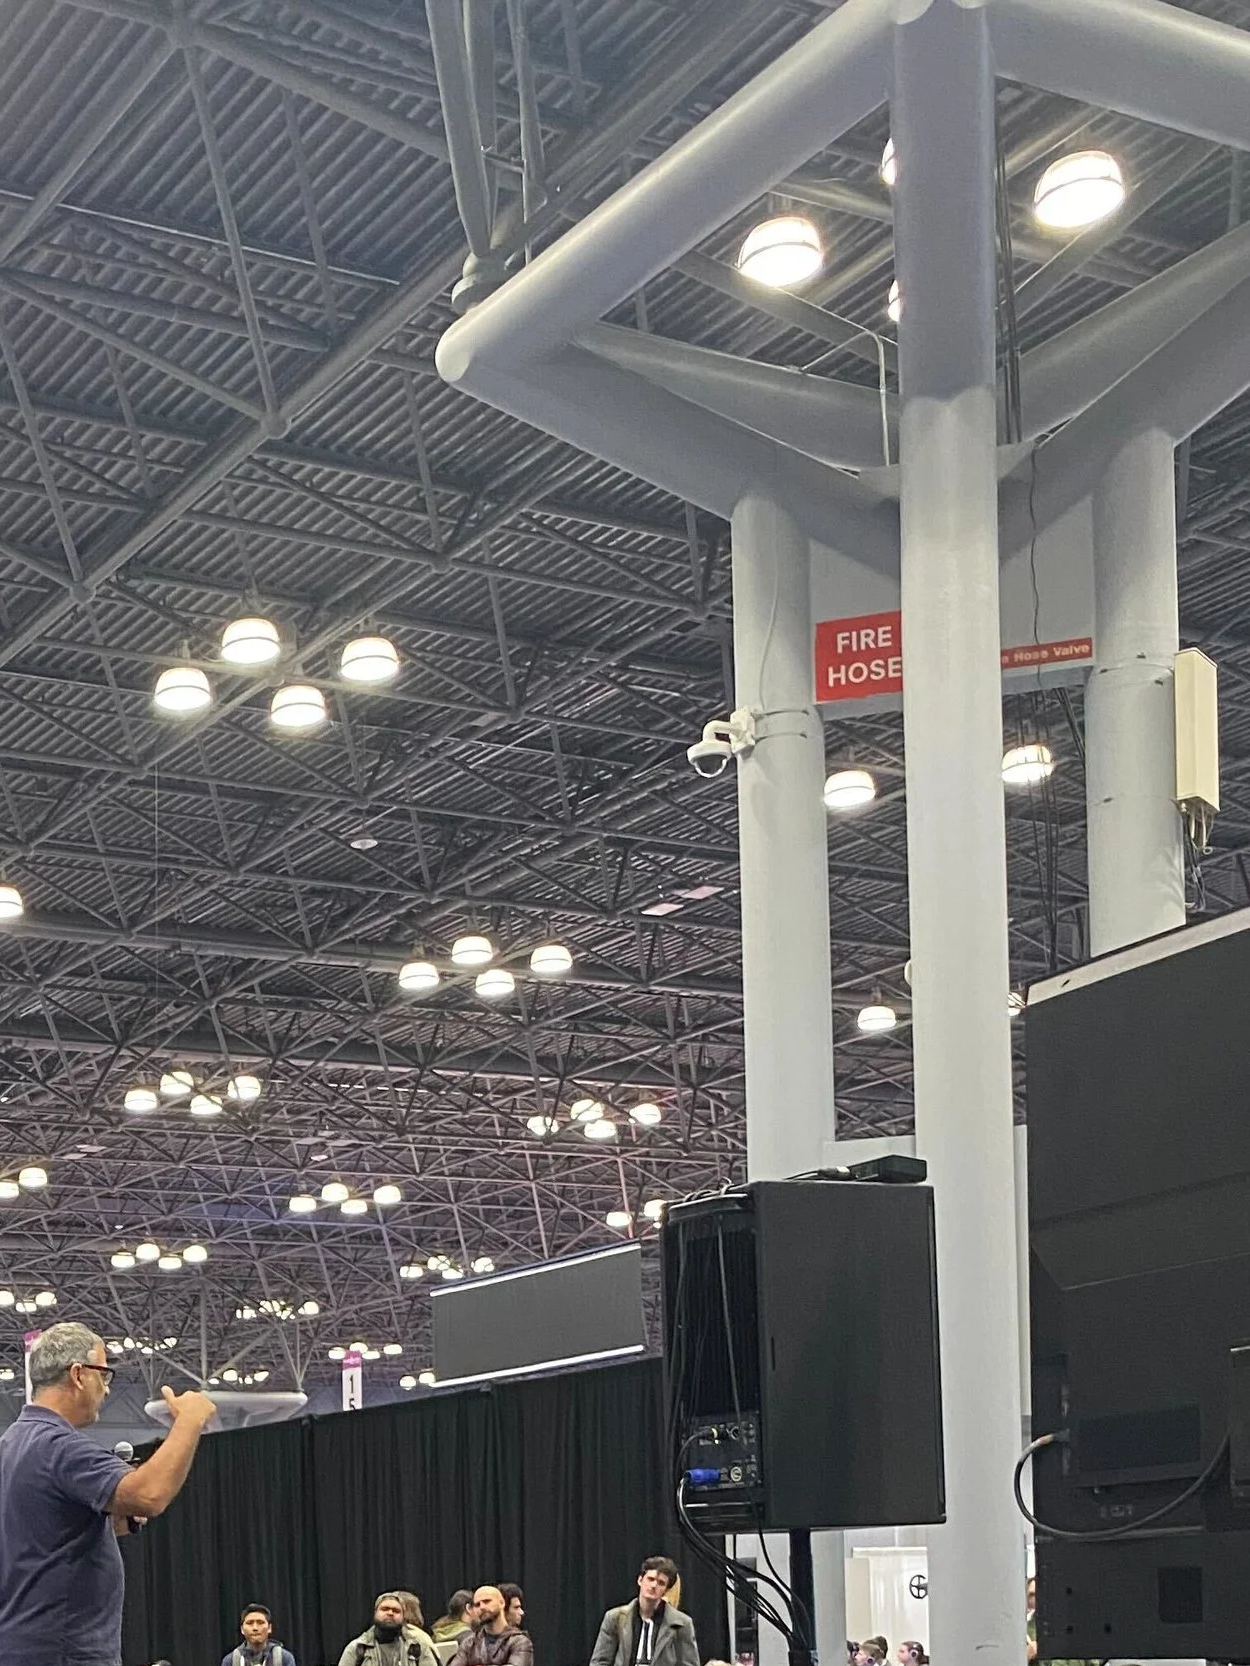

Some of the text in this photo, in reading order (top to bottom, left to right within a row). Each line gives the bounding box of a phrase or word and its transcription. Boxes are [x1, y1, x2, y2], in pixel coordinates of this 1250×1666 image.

[837, 626, 892, 653] FIRE
[1013, 649, 1049, 663] Hose
[1054, 643, 1090, 657] Valve
[828, 657, 903, 687] HOSE
